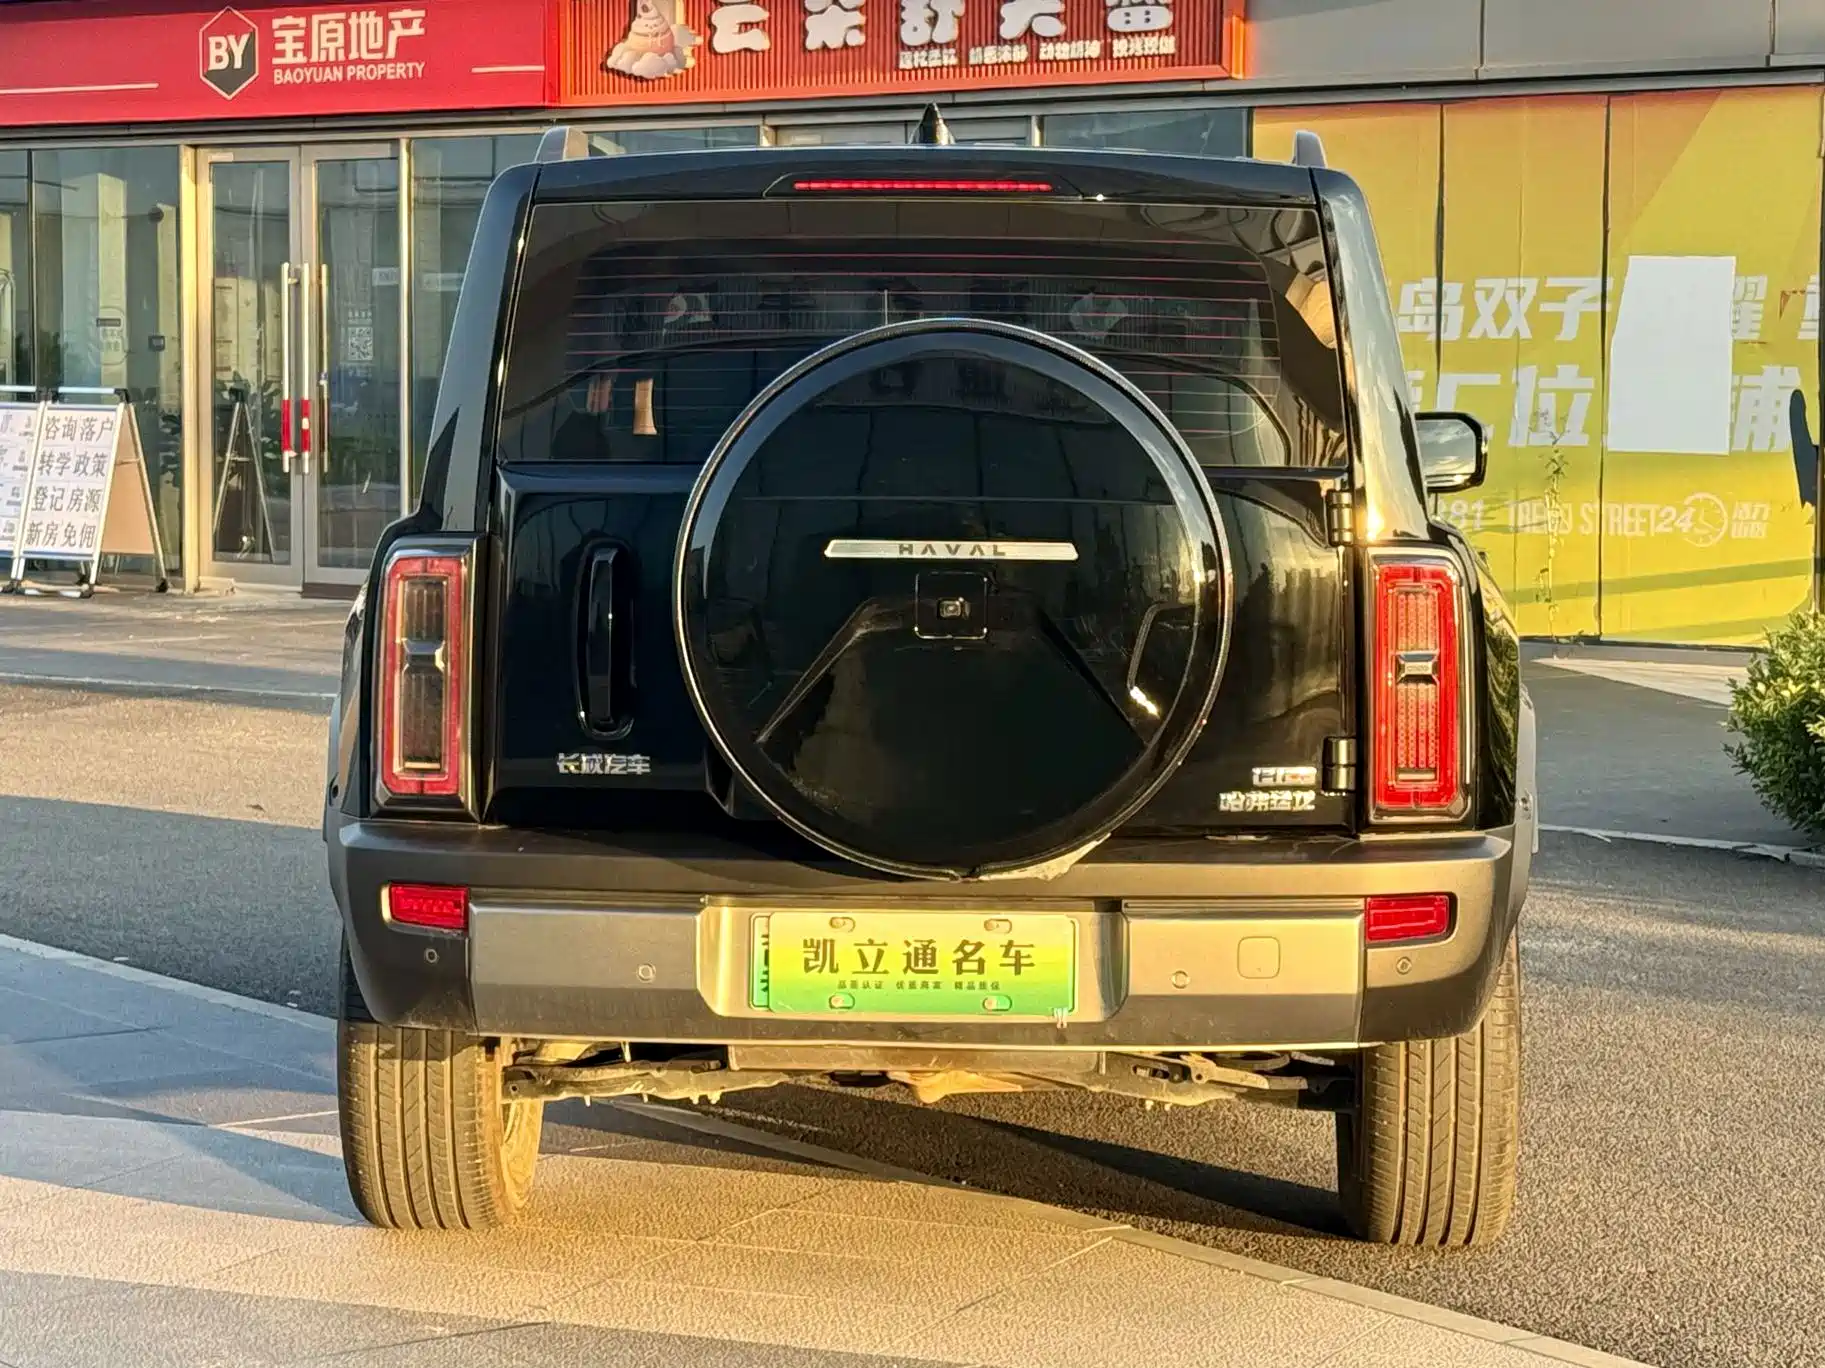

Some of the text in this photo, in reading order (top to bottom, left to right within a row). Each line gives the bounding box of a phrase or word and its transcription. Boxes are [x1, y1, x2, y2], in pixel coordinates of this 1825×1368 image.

[271, 8, 426, 65] 宝原地产
[207, 33, 251, 71] BY
[273, 61, 426, 86] BAOYUAN PROPERTY
[43, 414, 115, 443] 咨询落户
[37, 449, 109, 478] 转学政策
[30, 485, 104, 514] 登记房源
[24, 519, 97, 549] 新房免佣
[898, 543, 1006, 557] HAVAL
[556, 752, 652, 775] 长城汽车
[801, 937, 1037, 977] 凯立通名车
